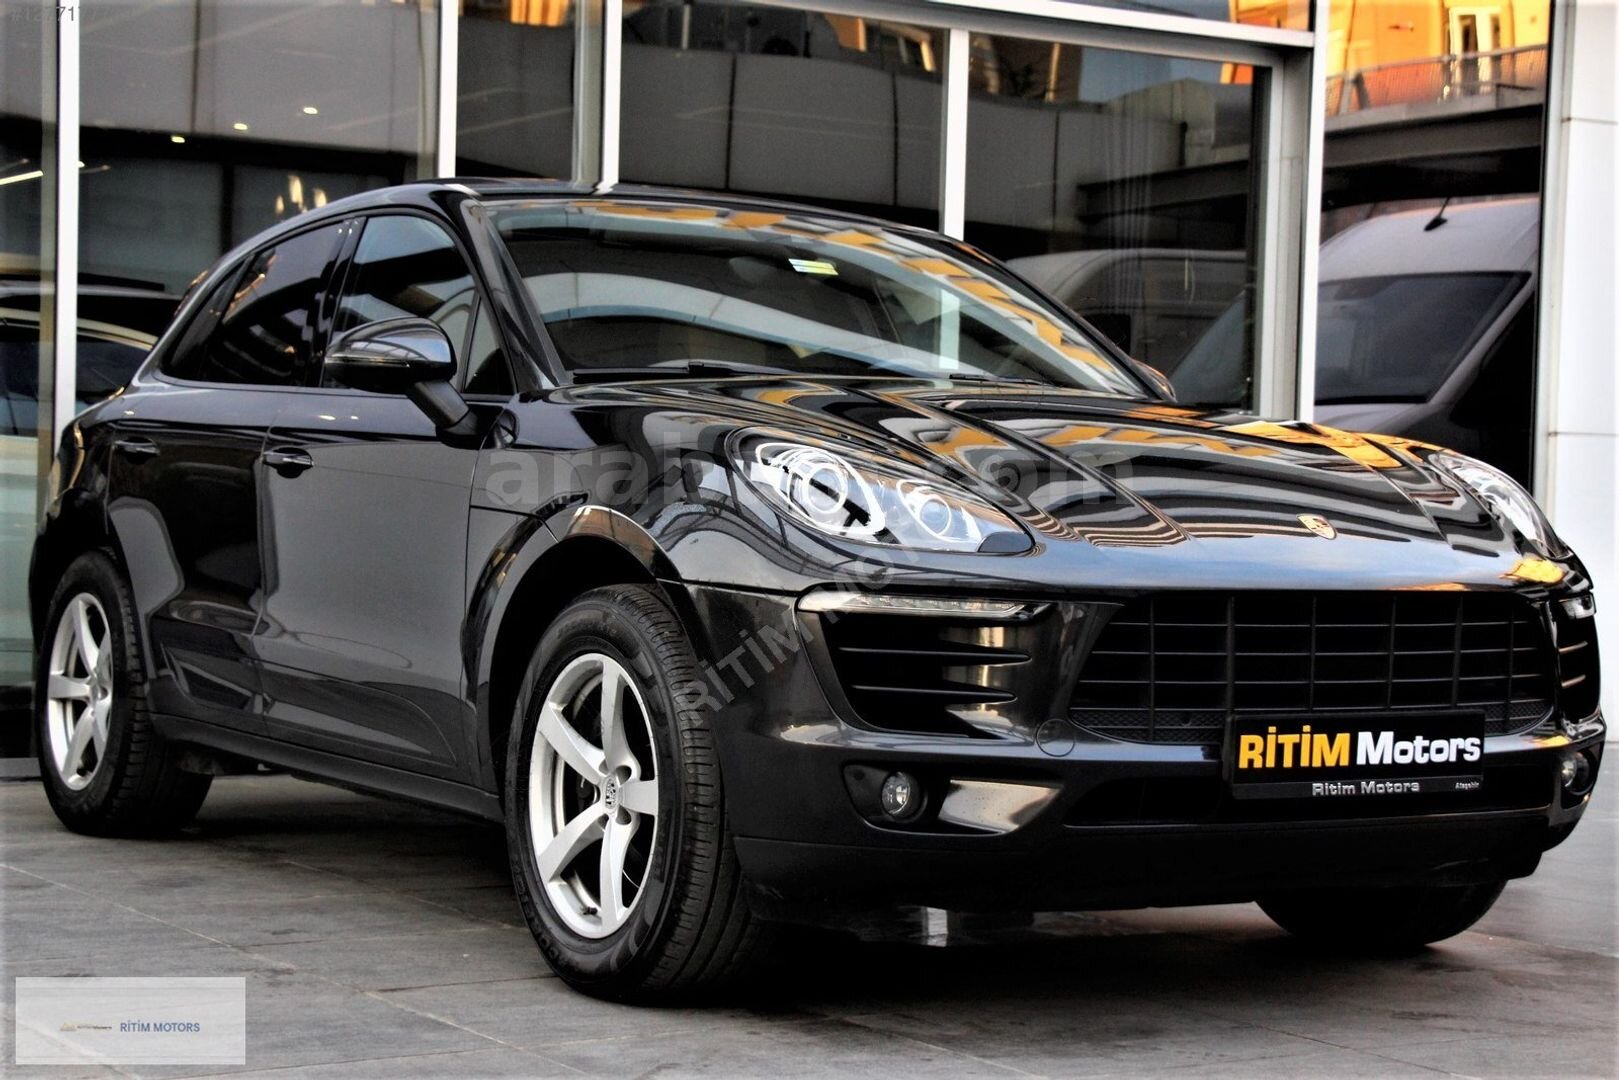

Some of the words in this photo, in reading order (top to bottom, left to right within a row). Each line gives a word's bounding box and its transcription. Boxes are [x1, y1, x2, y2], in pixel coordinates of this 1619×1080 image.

[1238, 724, 1351, 769] RİTİM
[1356, 730, 1481, 766] Motors
[1311, 782, 1356, 796] Ritim
[1360, 780, 1420, 794] Motors
